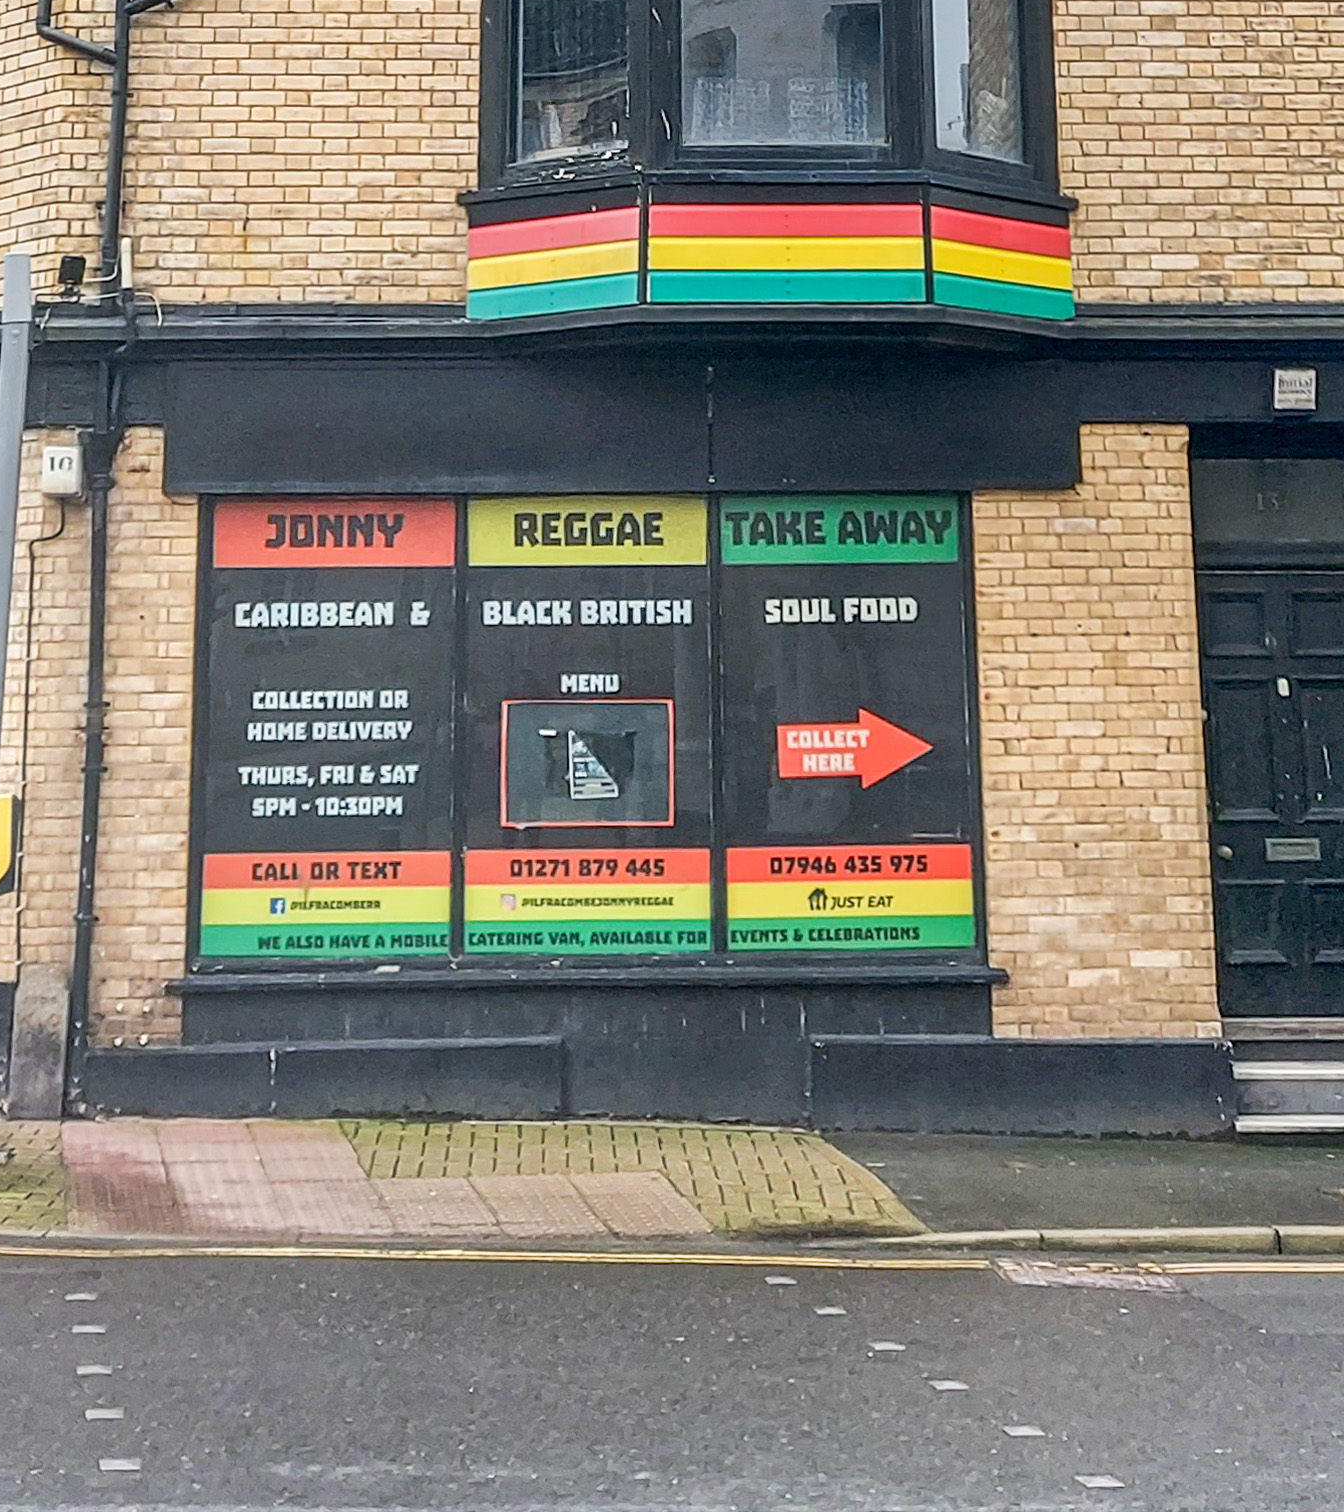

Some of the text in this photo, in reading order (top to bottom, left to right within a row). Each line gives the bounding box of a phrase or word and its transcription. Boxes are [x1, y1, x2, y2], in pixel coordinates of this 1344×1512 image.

[265, 509, 953, 548] JONNY REGGAE TAKE AWAY
[234, 597, 918, 628] CARIBBEAN & BLACK BRITISH SOUL FOOD
[560, 673, 620, 694] MENU
[252, 690, 408, 711] COLLECTION OR
[247, 720, 413, 741] HOME DELIVERY
[786, 730, 870, 749] COLLECT
[802, 753, 855, 772] HERE
[238, 764, 420, 787] THURS, FRI & SAT
[251, 798, 297, 817] 5PM
[314, 795, 404, 816] 10:30PM
[252, 855, 928, 881] CALL OR TEXT 01271 879 445 07946 435 975
[830, 896, 894, 910] JUST EAT
[258, 927, 920, 950] WE ALSO HAVE A MOBILE CATERING VAN, AVAILABLE FOR EVENTS & CELEBRATIONS
